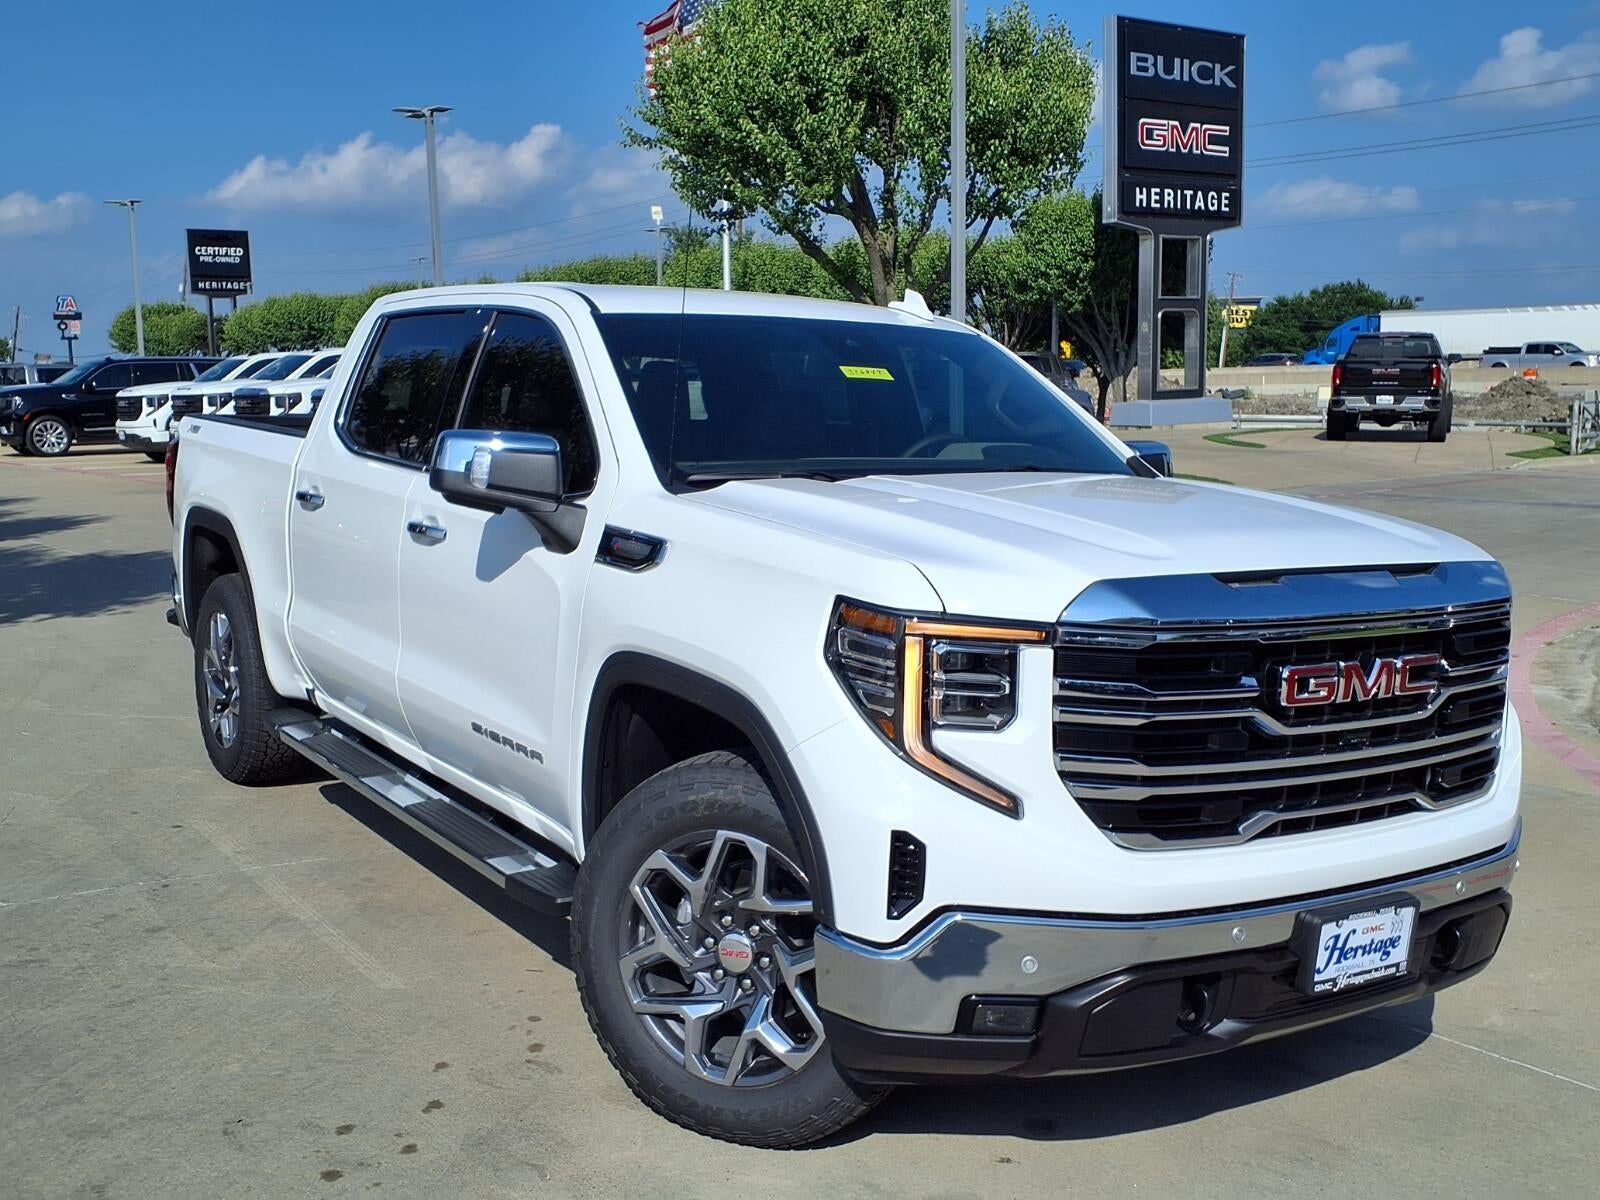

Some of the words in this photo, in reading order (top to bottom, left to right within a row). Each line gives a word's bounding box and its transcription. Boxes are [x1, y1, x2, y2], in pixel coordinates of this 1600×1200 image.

[1130, 52, 1237, 88] BUICK
[1138, 118, 1230, 157] GMC
[1135, 187, 1230, 212] HERITAGE
[195, 246, 243, 256] CERTIFIED
[198, 281, 245, 290] HERITAGE
[1280, 653, 1440, 707] GMC
[471, 721, 544, 765] SIERRA
[1361, 923, 1385, 935] GMC
[1315, 928, 1401, 975] Heritage
